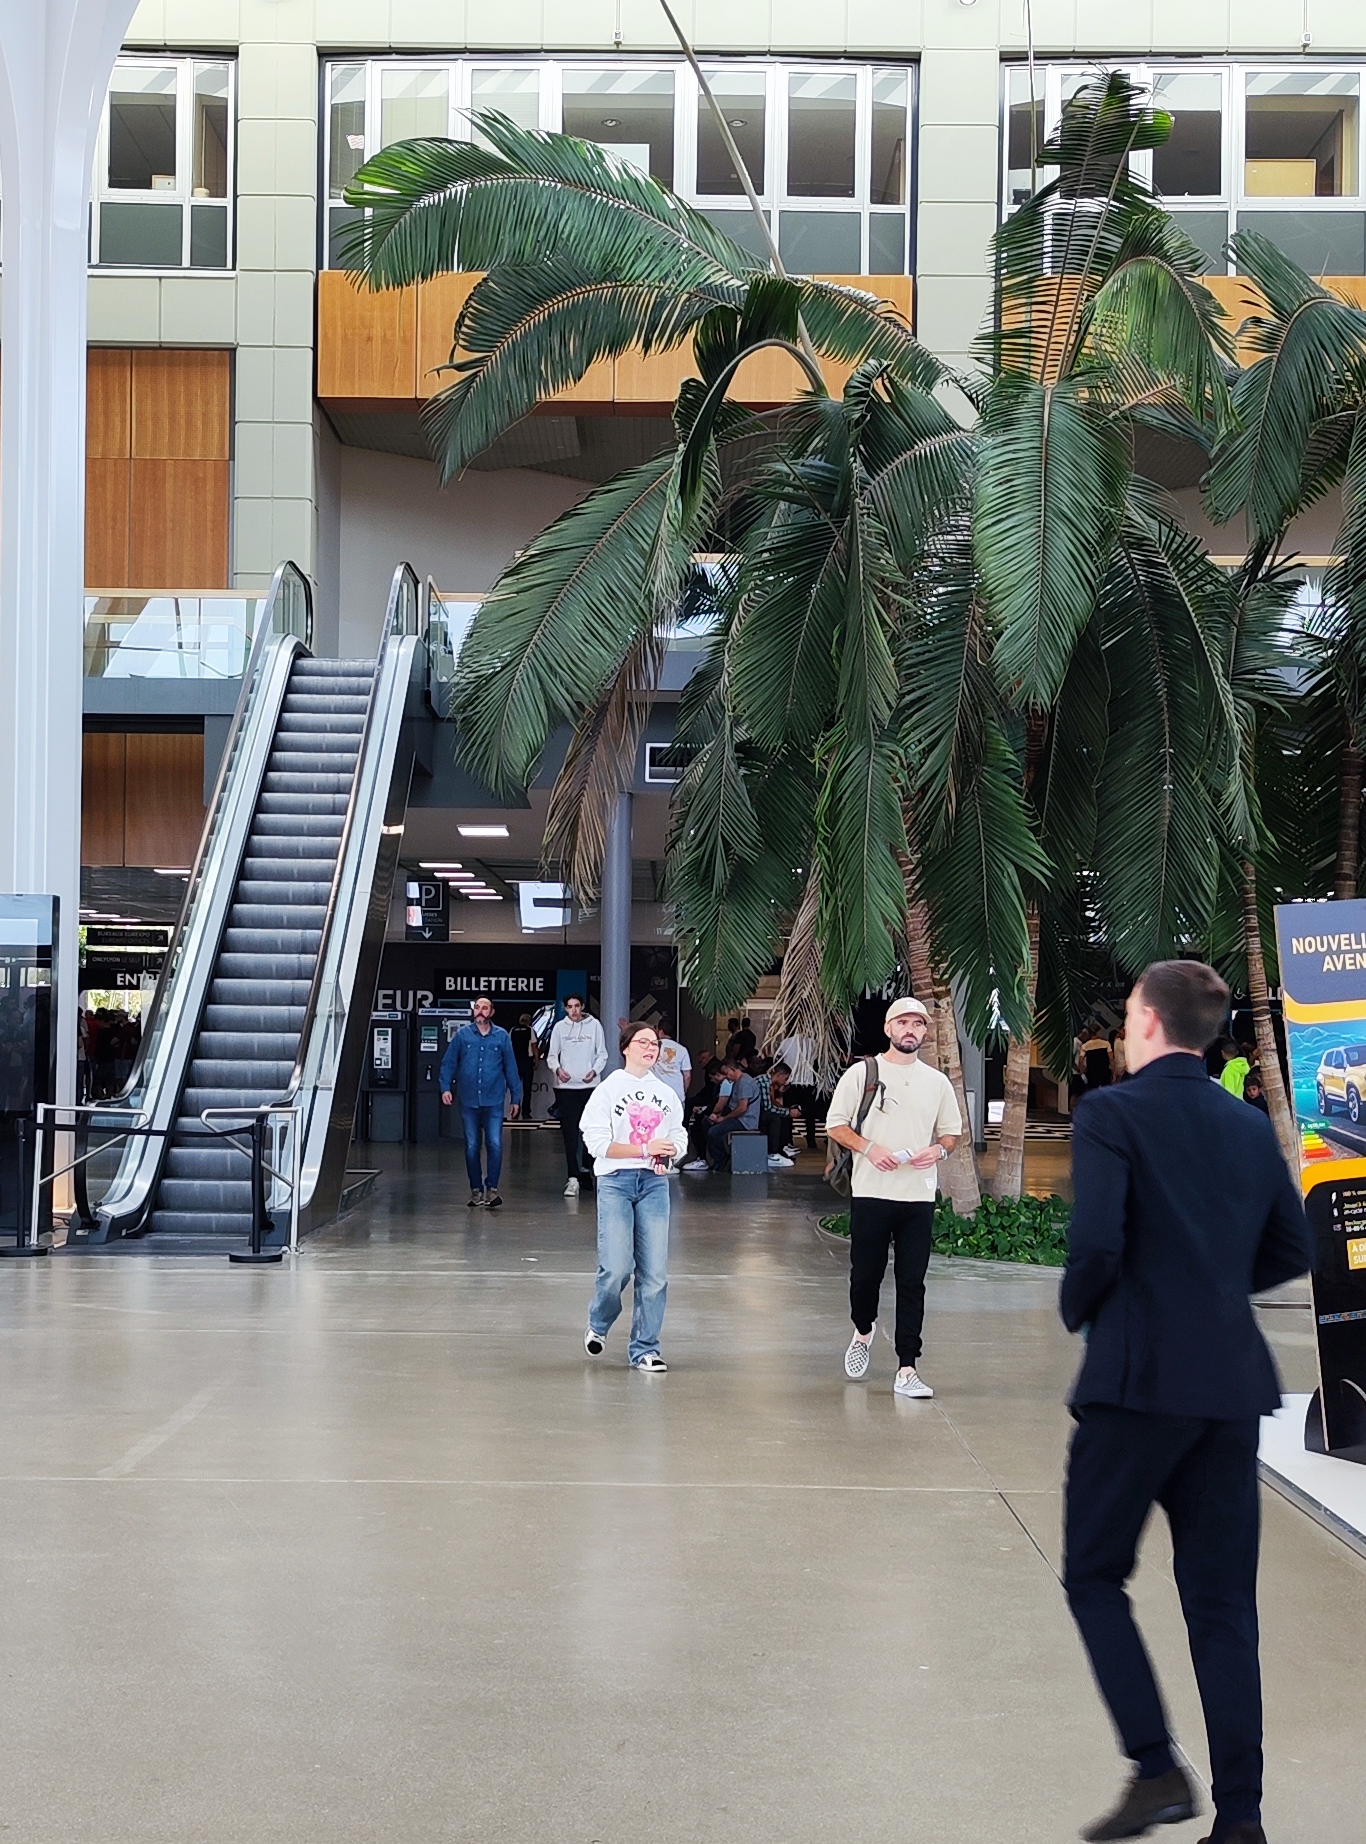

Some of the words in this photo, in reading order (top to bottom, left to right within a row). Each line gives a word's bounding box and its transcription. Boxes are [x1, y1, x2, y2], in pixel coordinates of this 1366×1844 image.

[422, 885, 436, 907] P
[445, 976, 544, 992] BILLETTERIE
[613, 1091, 645, 1117] HUG
[651, 1094, 672, 1116] ME
